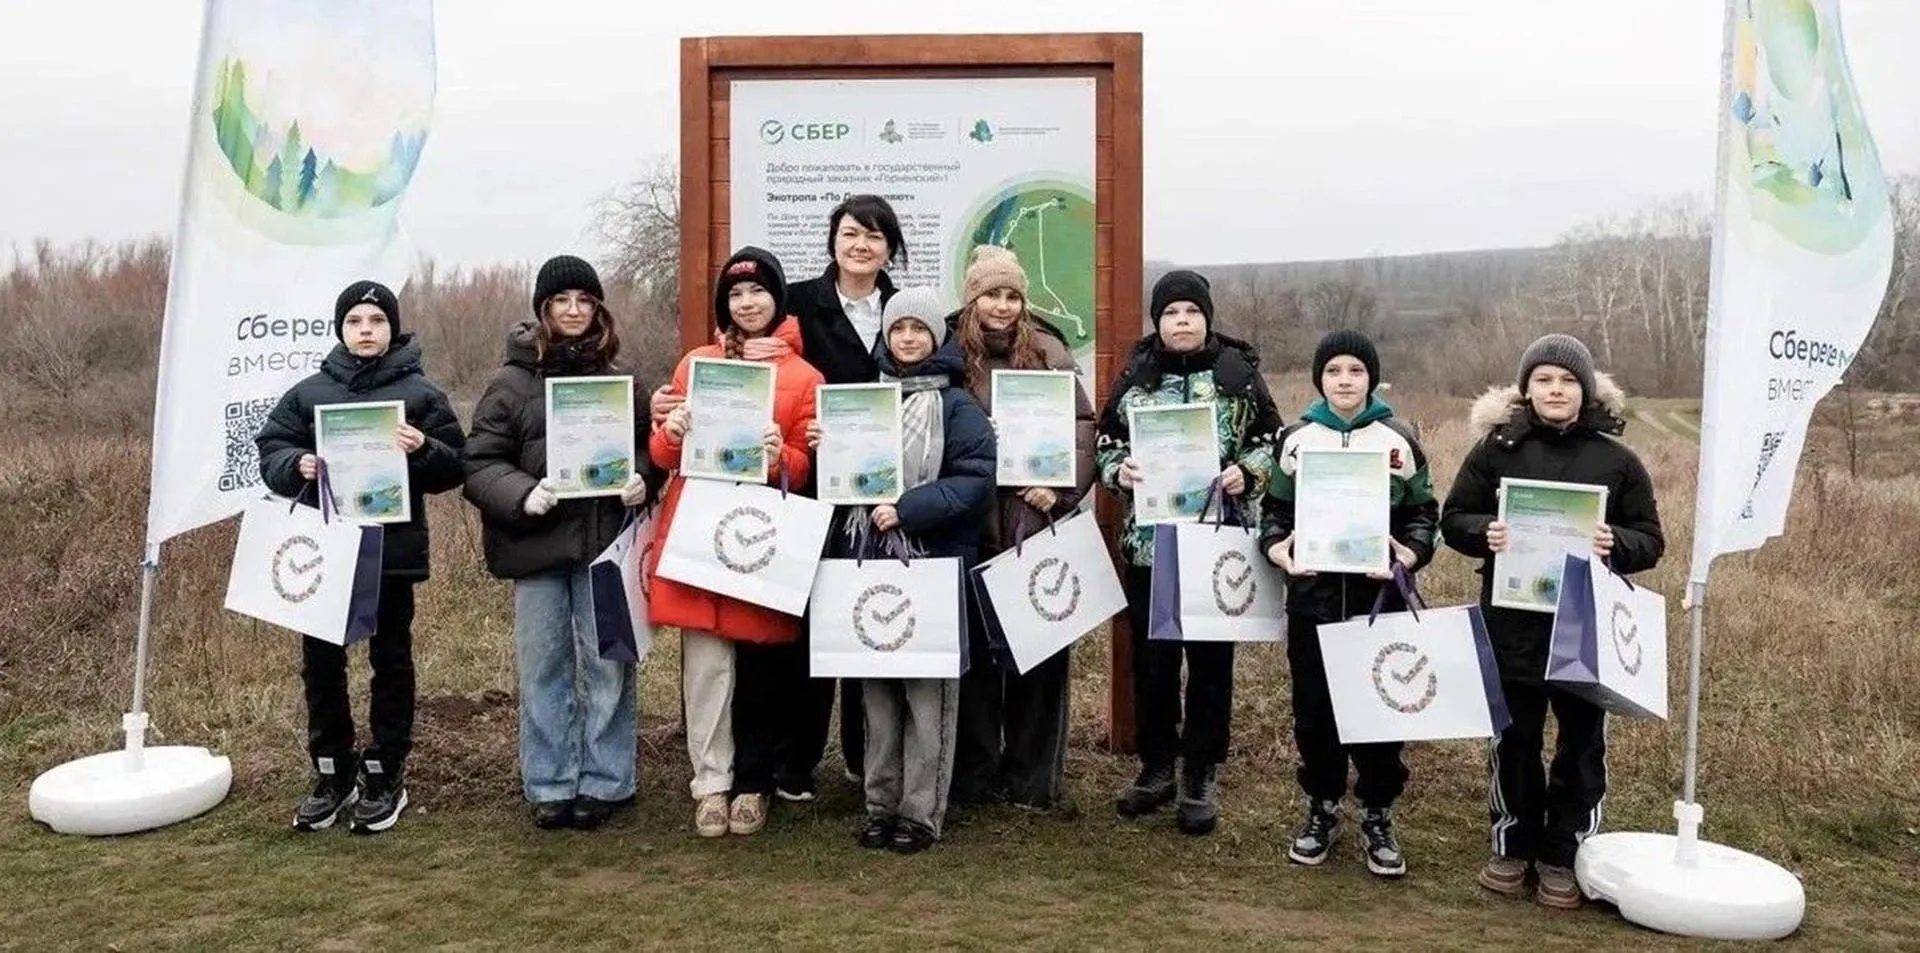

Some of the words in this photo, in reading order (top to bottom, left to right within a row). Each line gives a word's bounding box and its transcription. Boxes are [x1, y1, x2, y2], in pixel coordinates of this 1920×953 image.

[791, 124, 850, 140] СБЕР
[766, 162, 800, 173] Добро
[801, 164, 862, 172] пожаловать
[872, 161, 961, 173] государственный
[766, 174, 824, 184] природный
[826, 174, 871, 182] заказник
[766, 192, 818, 203] Экотропа
[820, 192, 841, 201] «По
[237, 313, 336, 342] Сберег
[227, 351, 325, 377] вместе
